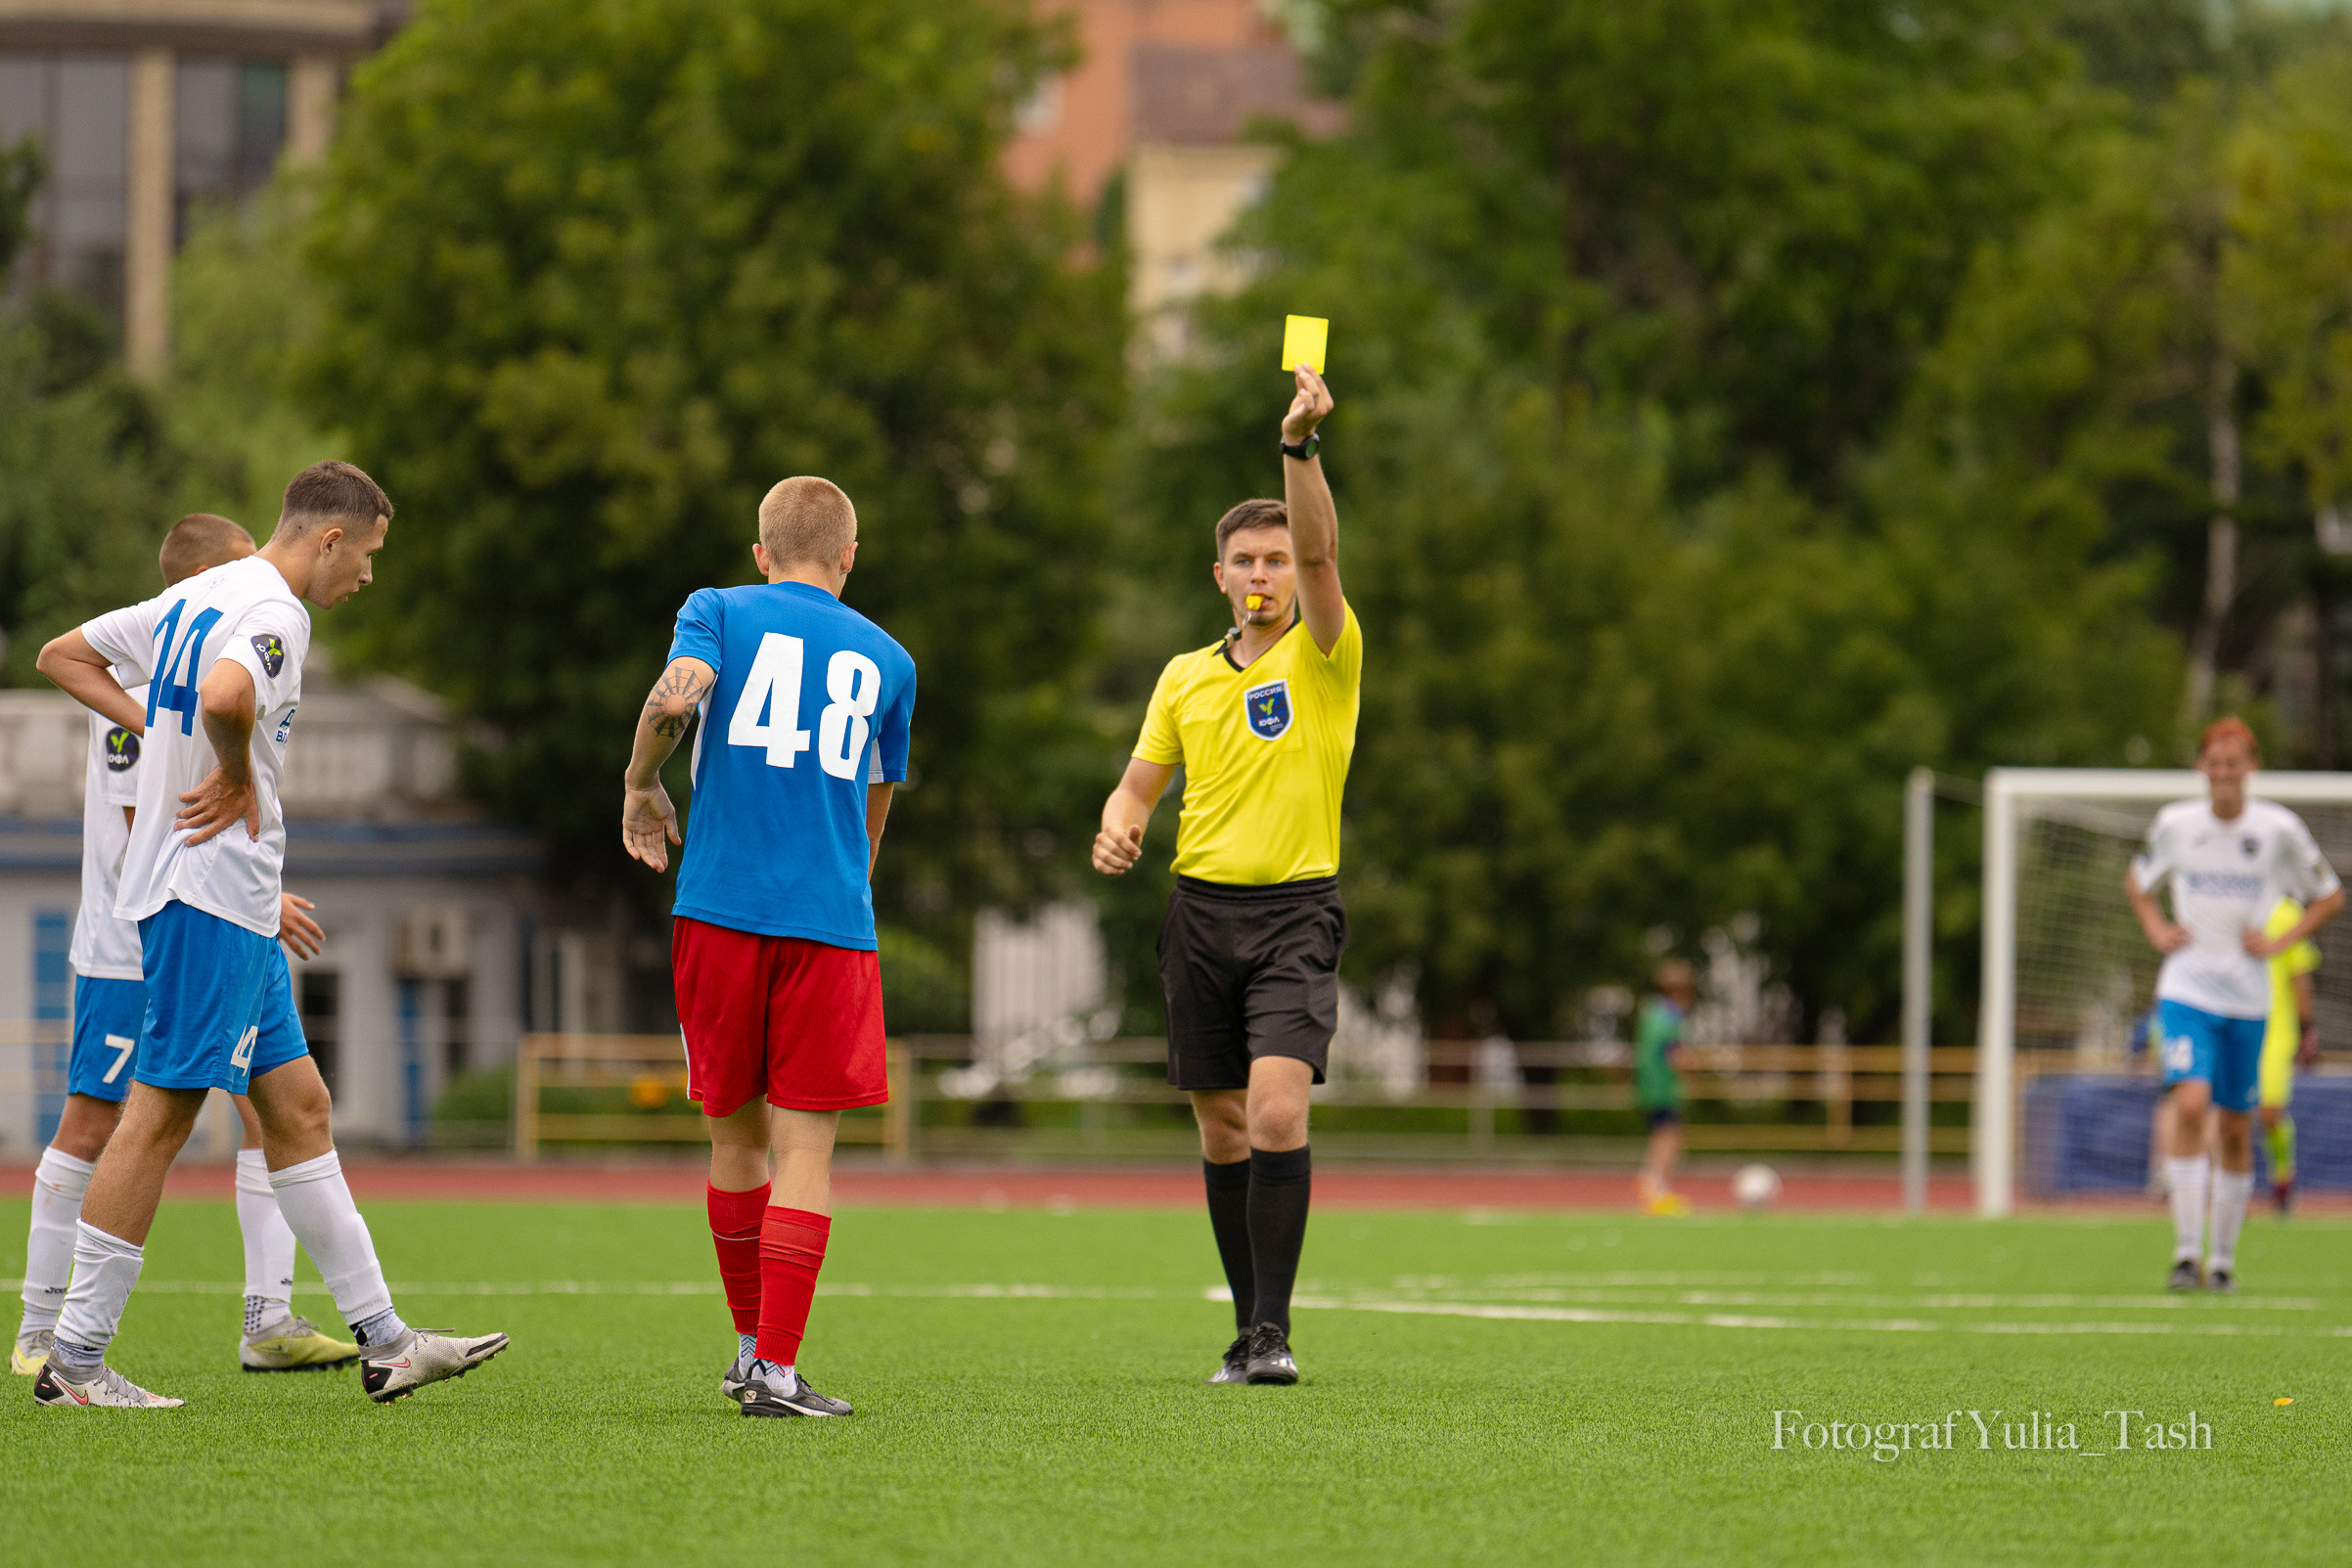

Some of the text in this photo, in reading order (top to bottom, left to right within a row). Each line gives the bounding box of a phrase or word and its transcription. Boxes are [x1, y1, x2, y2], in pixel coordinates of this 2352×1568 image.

[145, 599, 224, 737] 14
[1248, 686, 1283, 700] РОССИЯ
[727, 632, 882, 782] 48
[1258, 716, 1281, 727] ЮФЛ
[102, 1033, 135, 1084] 7
